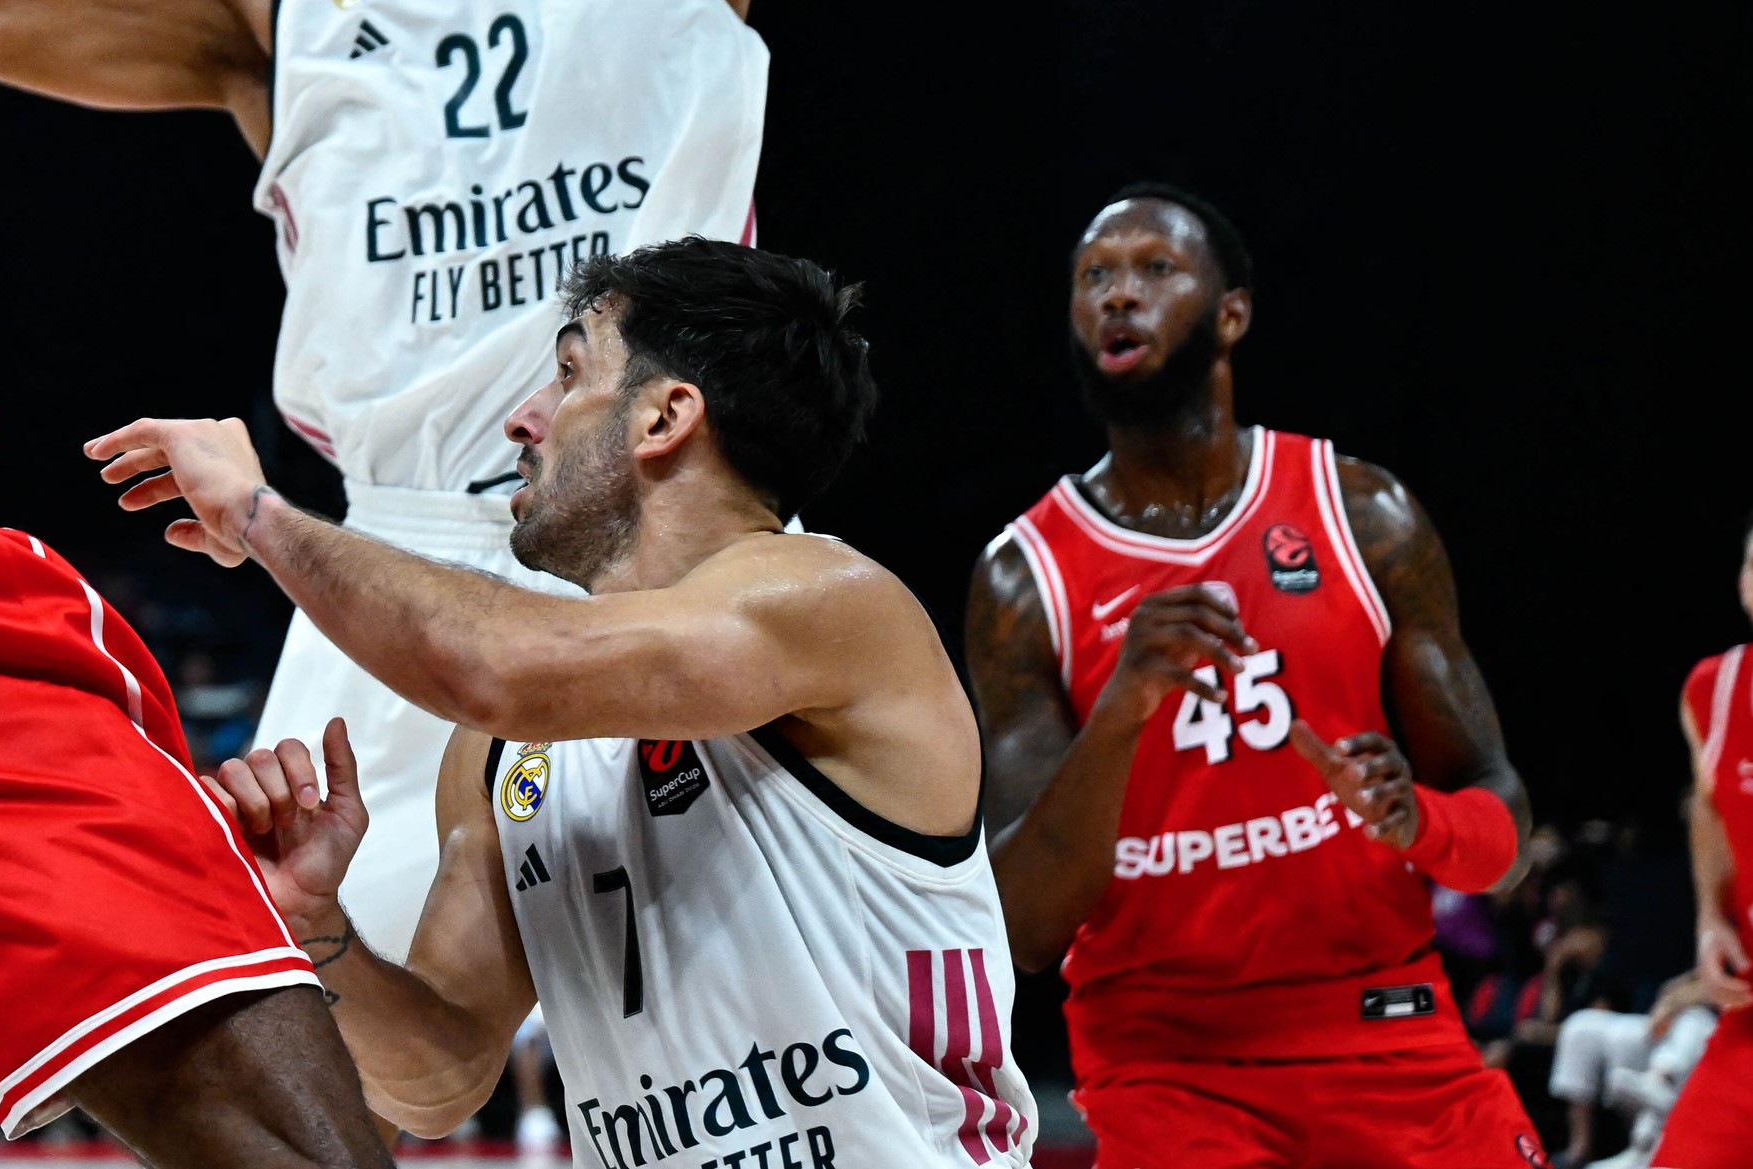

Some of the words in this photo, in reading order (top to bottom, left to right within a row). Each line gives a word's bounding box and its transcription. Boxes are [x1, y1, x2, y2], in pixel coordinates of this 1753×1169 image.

[434, 13, 530, 139] 22
[365, 155, 651, 263] Emirates
[411, 266, 465, 325] FLY
[1172, 648, 1294, 766] 45
[649, 767, 701, 802] SuperCup
[592, 865, 645, 1020] 7
[577, 1027, 871, 1169] Emirates
